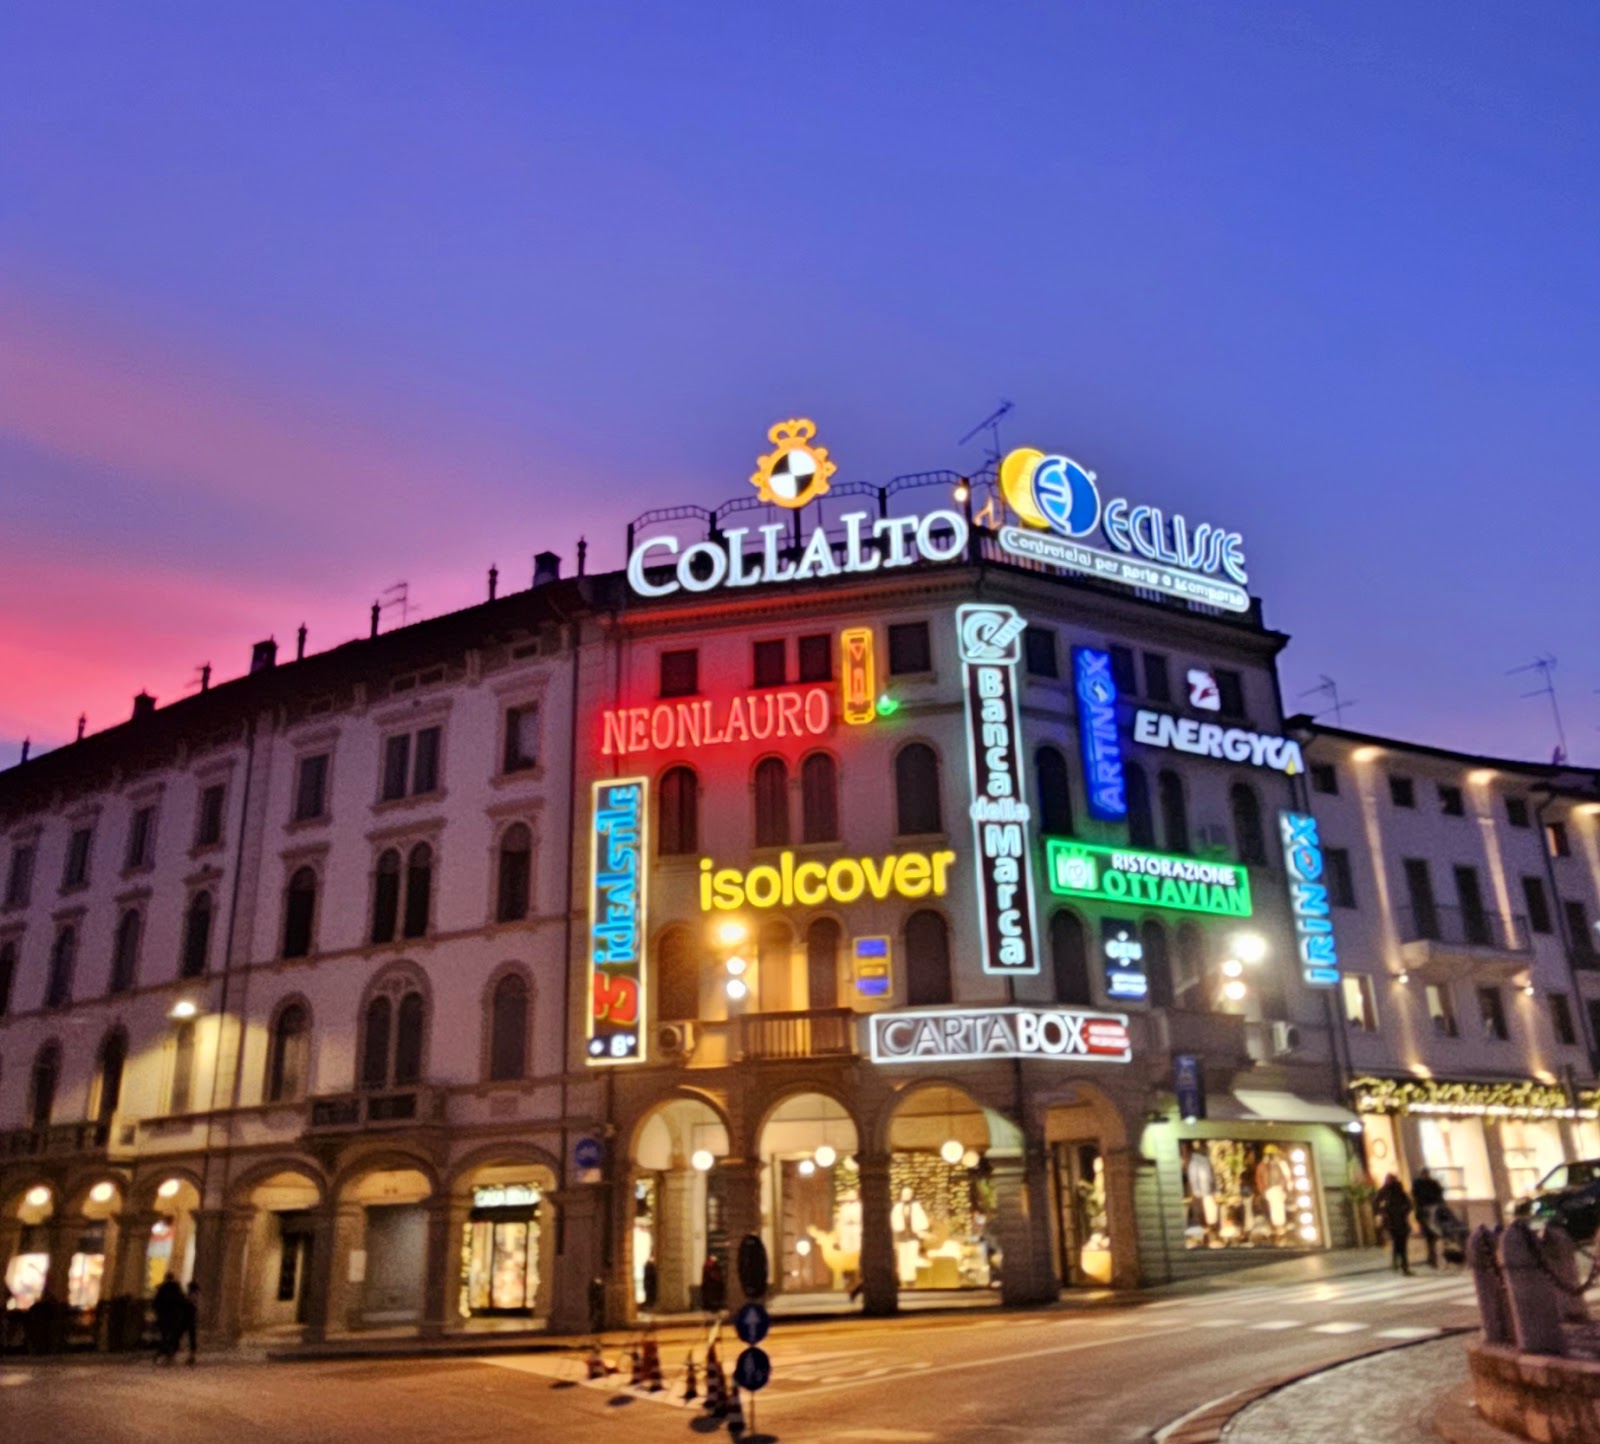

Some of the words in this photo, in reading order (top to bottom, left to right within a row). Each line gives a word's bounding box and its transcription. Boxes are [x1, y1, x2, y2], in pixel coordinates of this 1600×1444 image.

[627, 511, 969, 597] COLLALTO
[1095, 557, 1119, 573] per
[1105, 498, 1248, 583] ECLISSE
[602, 688, 830, 755] NEONLAURO
[977, 667, 1013, 797] Banca
[1078, 648, 1128, 814] ARTINOX
[969, 796, 1031, 822] della
[699, 850, 956, 912] isolcover
[984, 824, 1027, 965] Marca
[1102, 869, 1249, 914] OTTAVIAN
[1111, 852, 1236, 886] RISTORAZIONE
[1282, 814, 1340, 984] IRINOX
